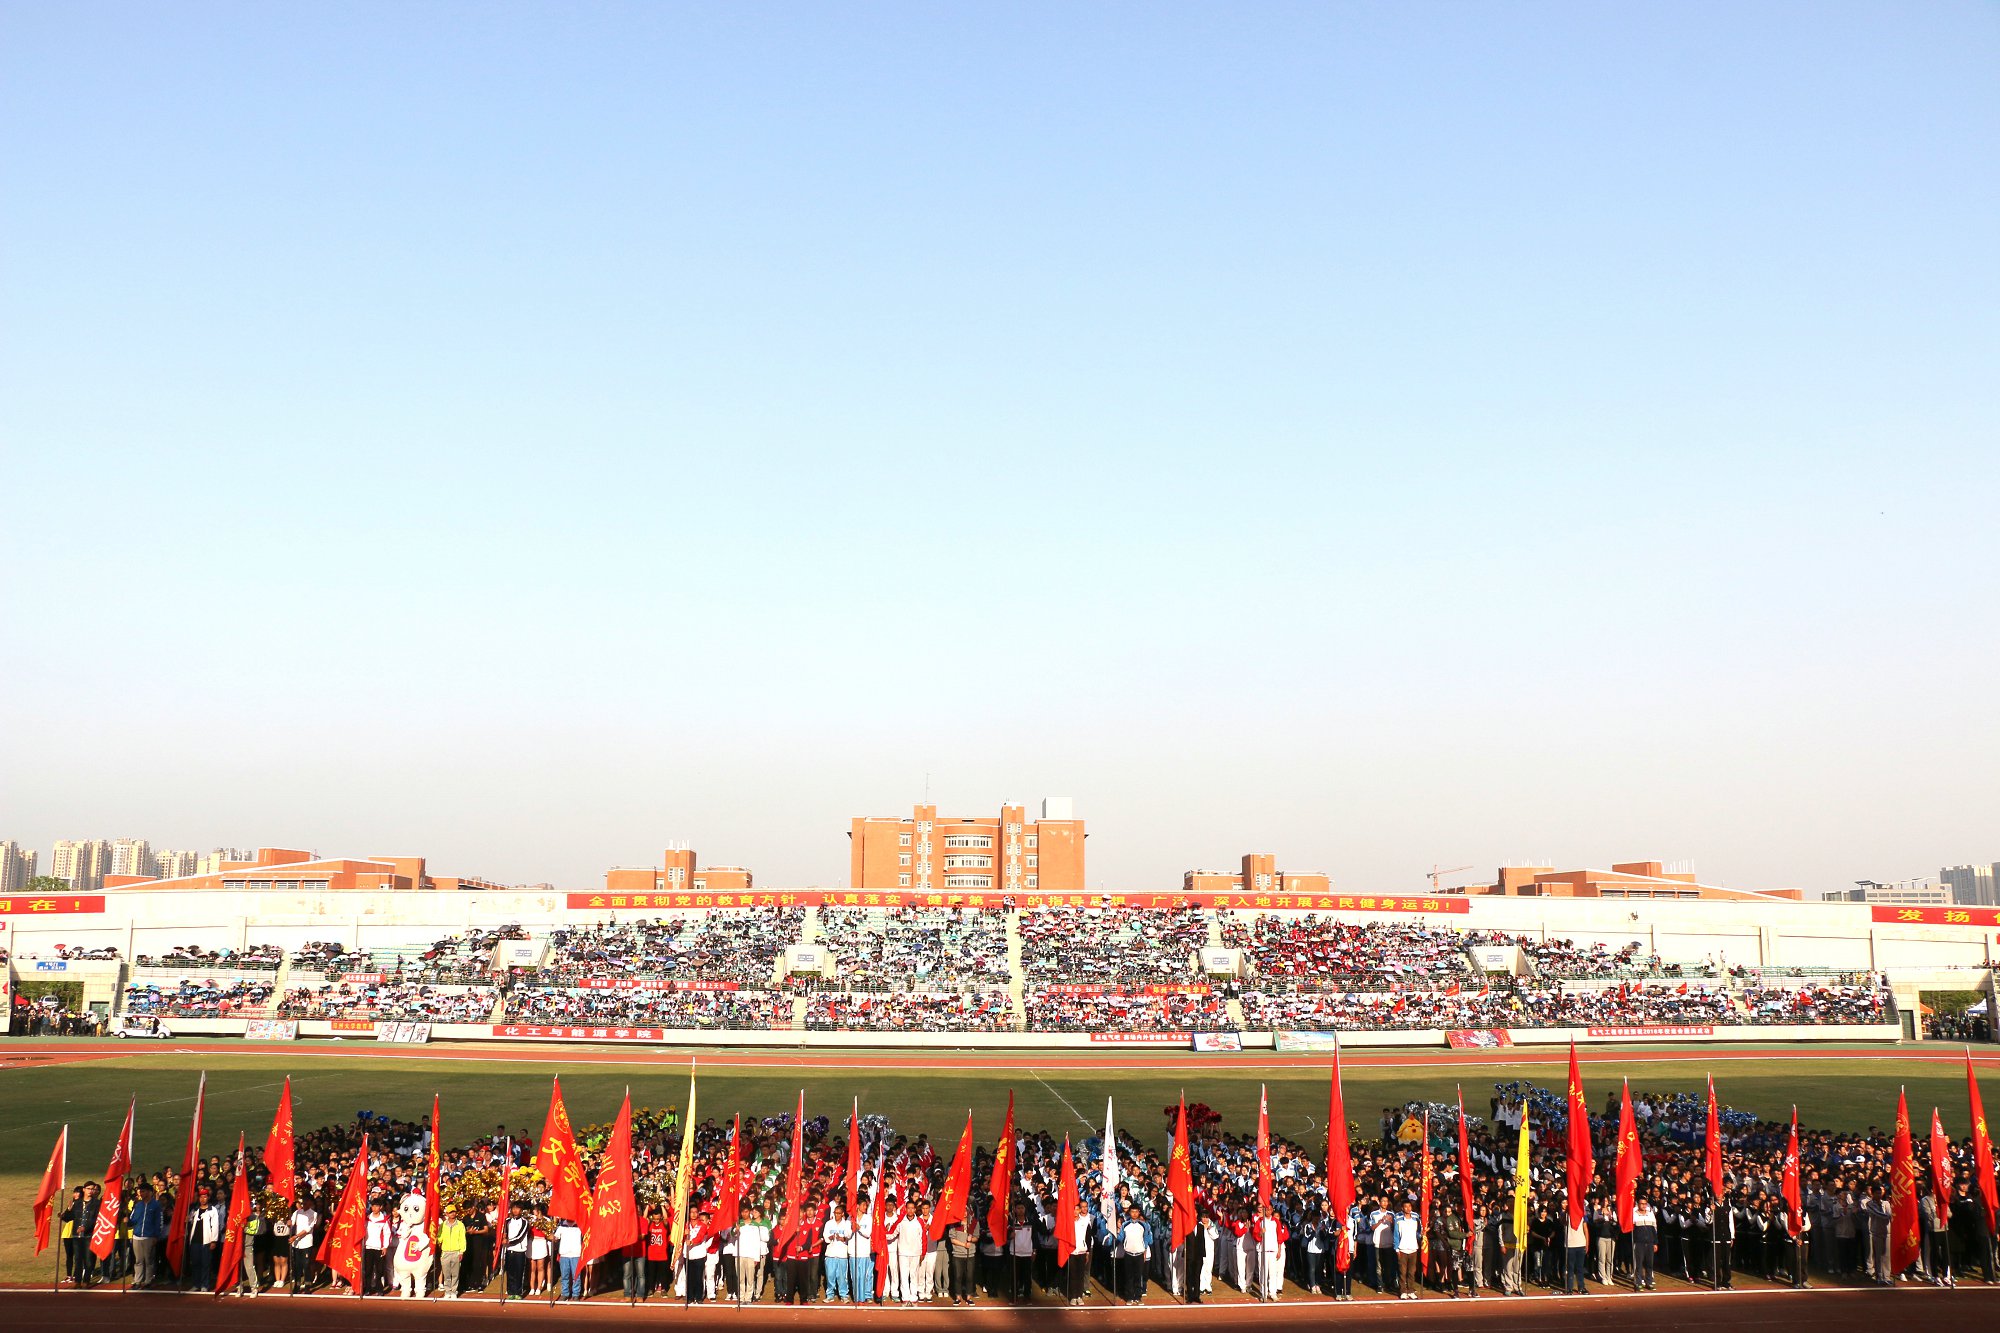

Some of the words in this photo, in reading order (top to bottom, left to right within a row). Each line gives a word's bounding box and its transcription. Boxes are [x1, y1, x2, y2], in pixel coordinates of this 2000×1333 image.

[504, 1027, 652, 1038] 化工与能源学院
[651, 1234, 663, 1245] 34
